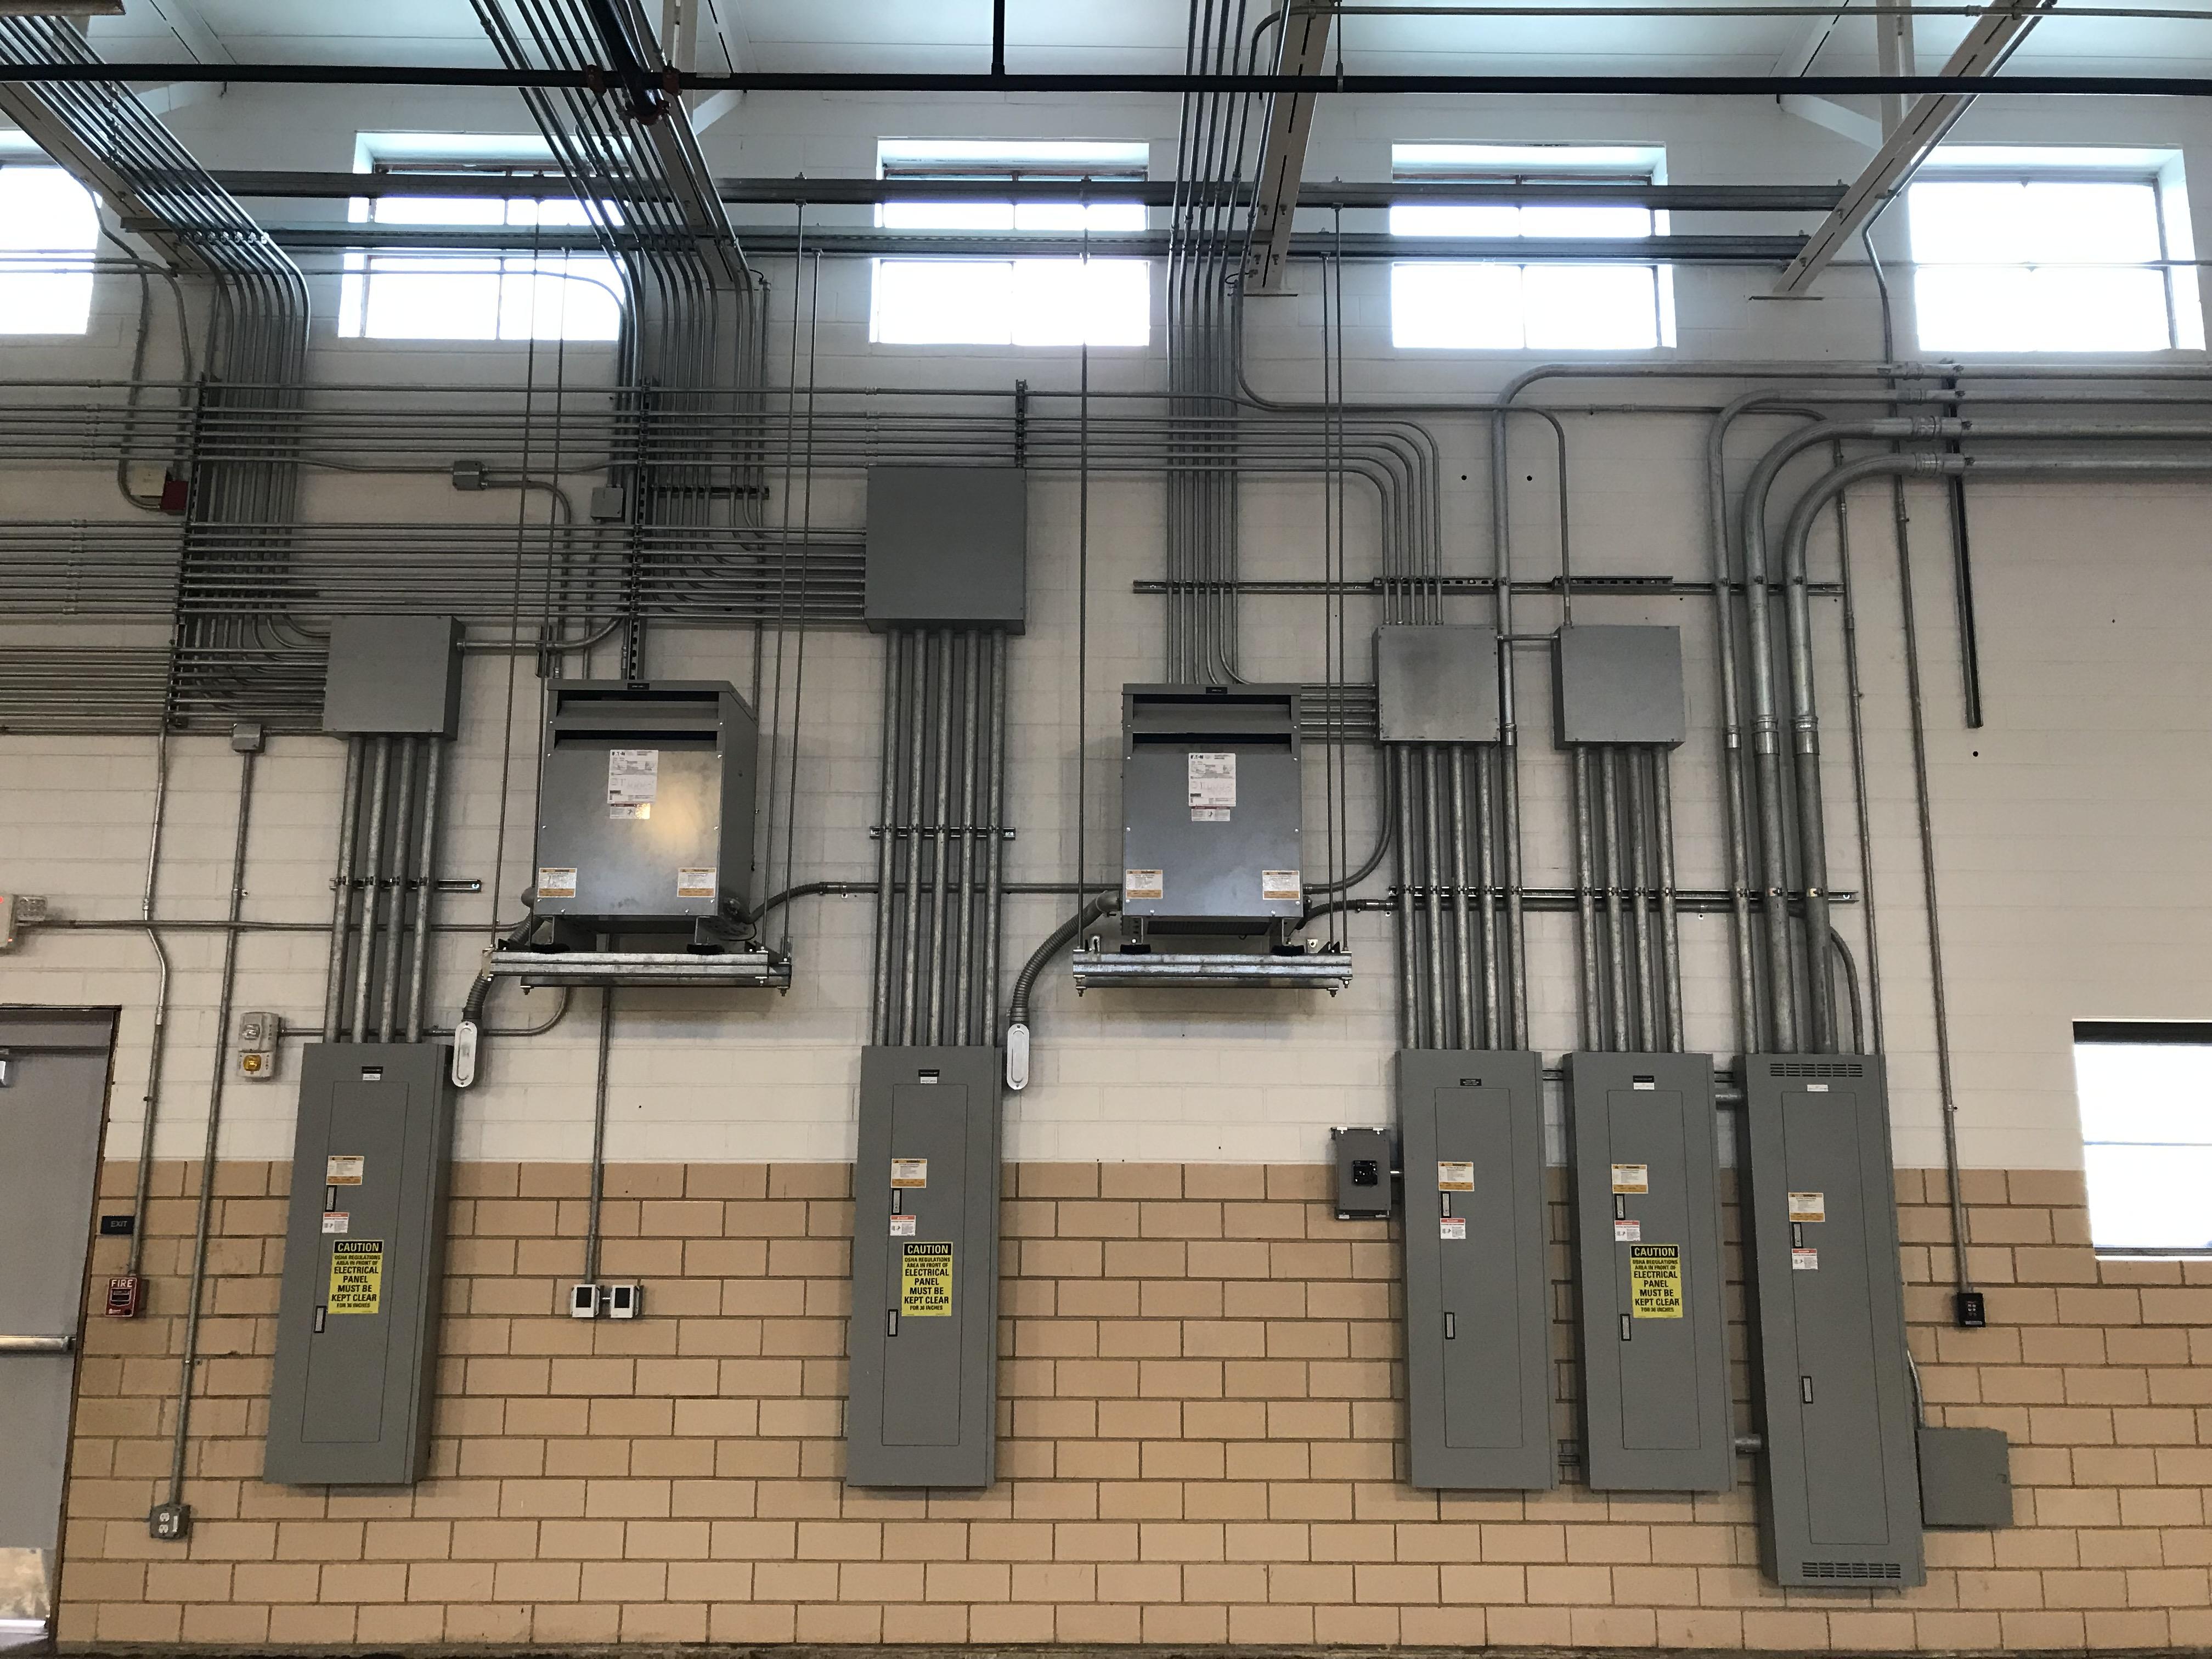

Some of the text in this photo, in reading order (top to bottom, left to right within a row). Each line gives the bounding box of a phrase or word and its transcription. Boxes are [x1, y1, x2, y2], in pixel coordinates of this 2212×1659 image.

[337, 1243, 379, 1251] CAUTION
[907, 1245, 948, 1254] CAUTION
[1634, 1247, 1675, 1256] CAUTION
[111, 1279, 133, 1288] FIRE
